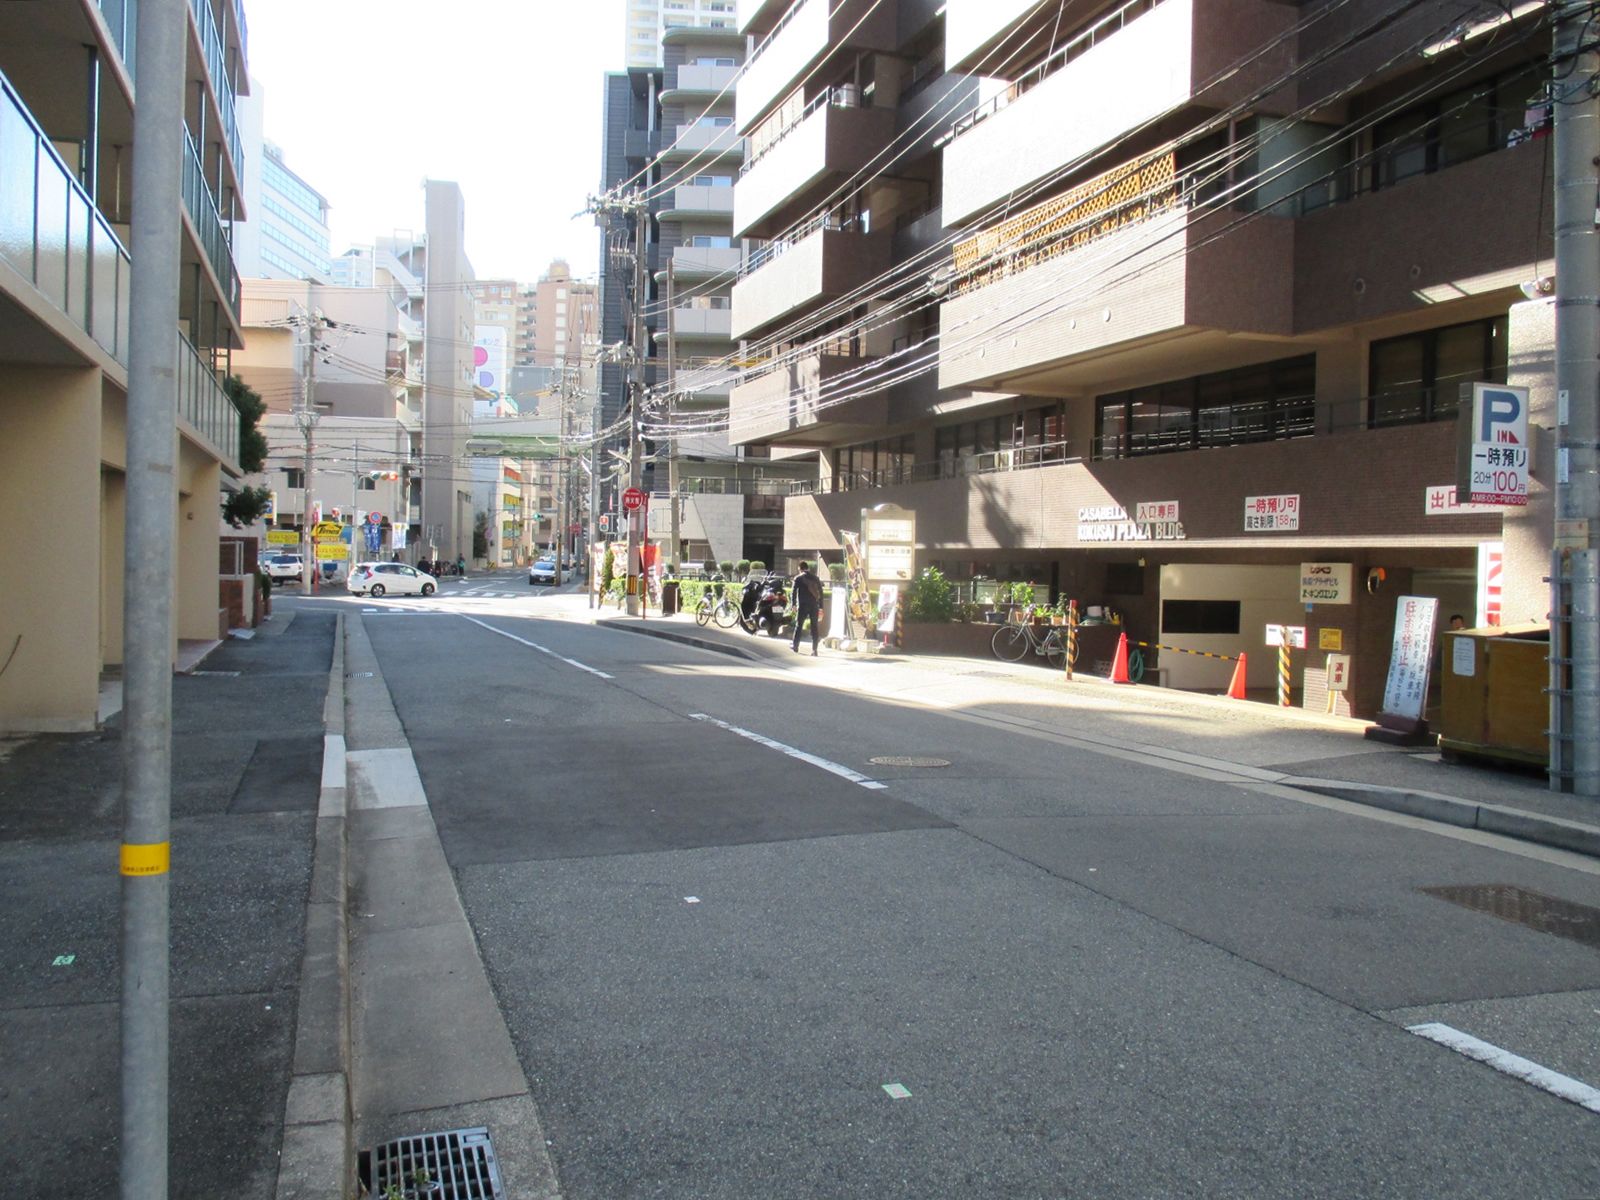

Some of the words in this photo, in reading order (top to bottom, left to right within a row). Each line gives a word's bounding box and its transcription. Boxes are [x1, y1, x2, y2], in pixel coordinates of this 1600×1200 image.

[1481, 390, 1520, 442] P
[1497, 430, 1508, 443] IN
[1475, 448, 1526, 467] 一時預り
[1139, 504, 1176, 519] 入口専用
[1247, 497, 1298, 513] 一時預り可
[1117, 523, 1152, 541] PLAZA
